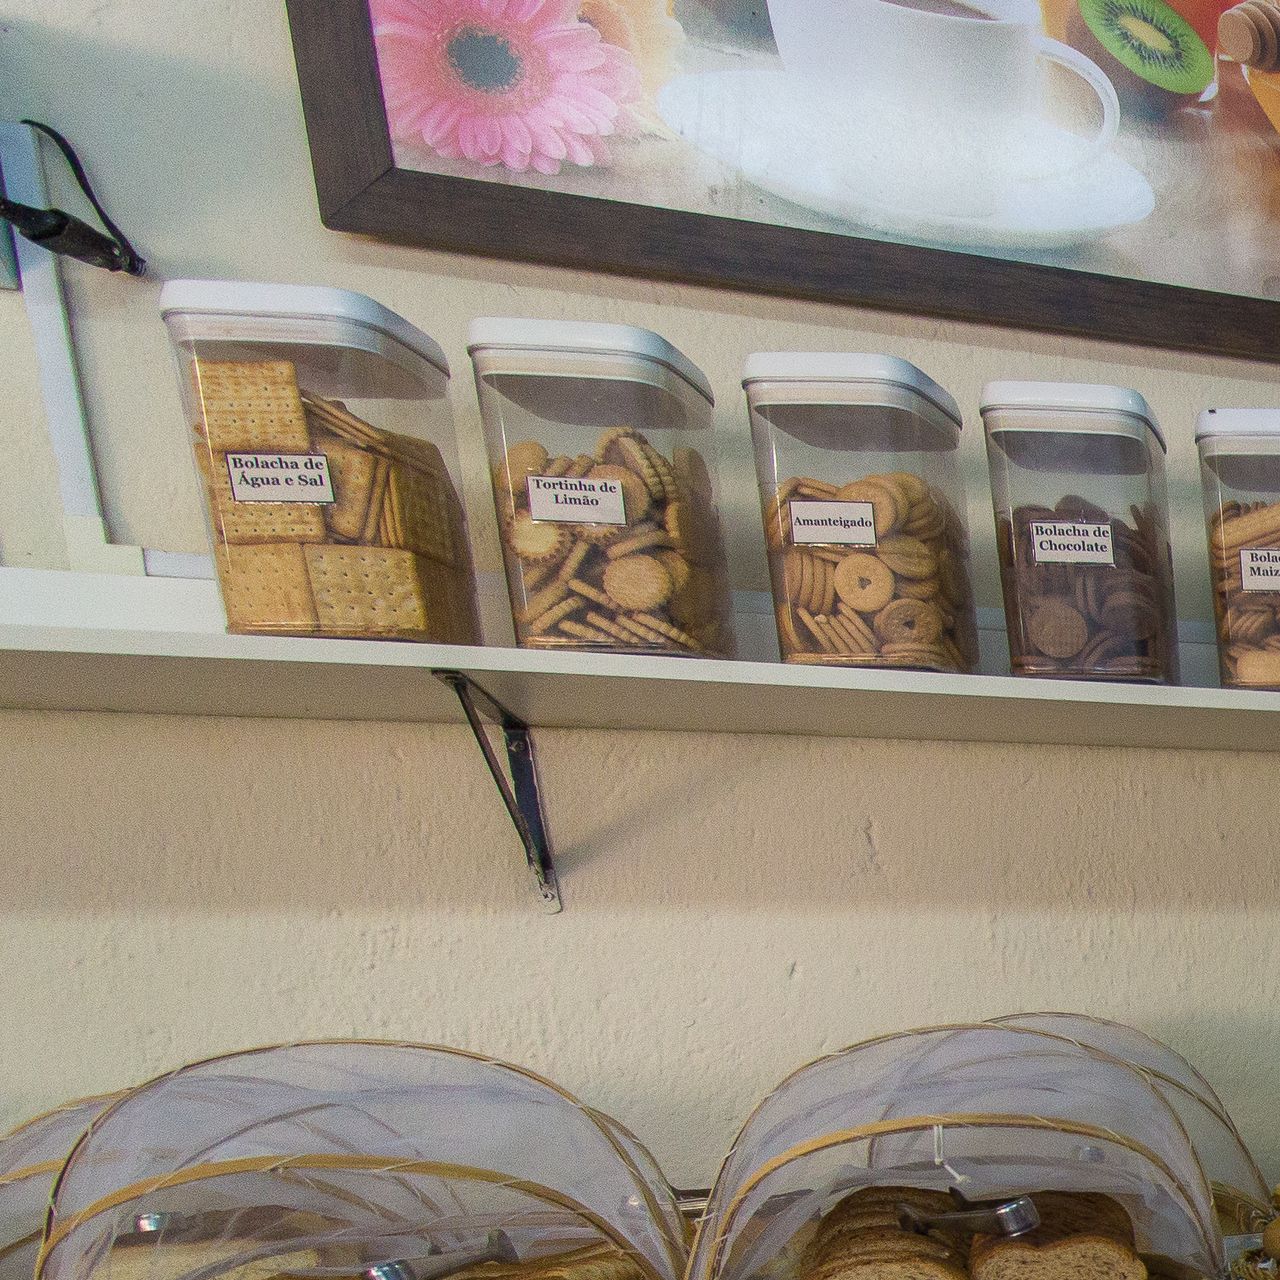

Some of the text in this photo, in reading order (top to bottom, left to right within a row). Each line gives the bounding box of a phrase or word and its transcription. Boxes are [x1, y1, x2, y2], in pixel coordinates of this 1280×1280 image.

[231, 456, 324, 470] Bolacha de
[238, 470, 325, 488] Água e Sal
[533, 478, 618, 494] Tortinha de
[553, 493, 600, 507] Limão
[793, 516, 873, 529] Amanteigado
[1034, 524, 1110, 538] Bolacha de
[1039, 539, 1108, 553] Chocolate
